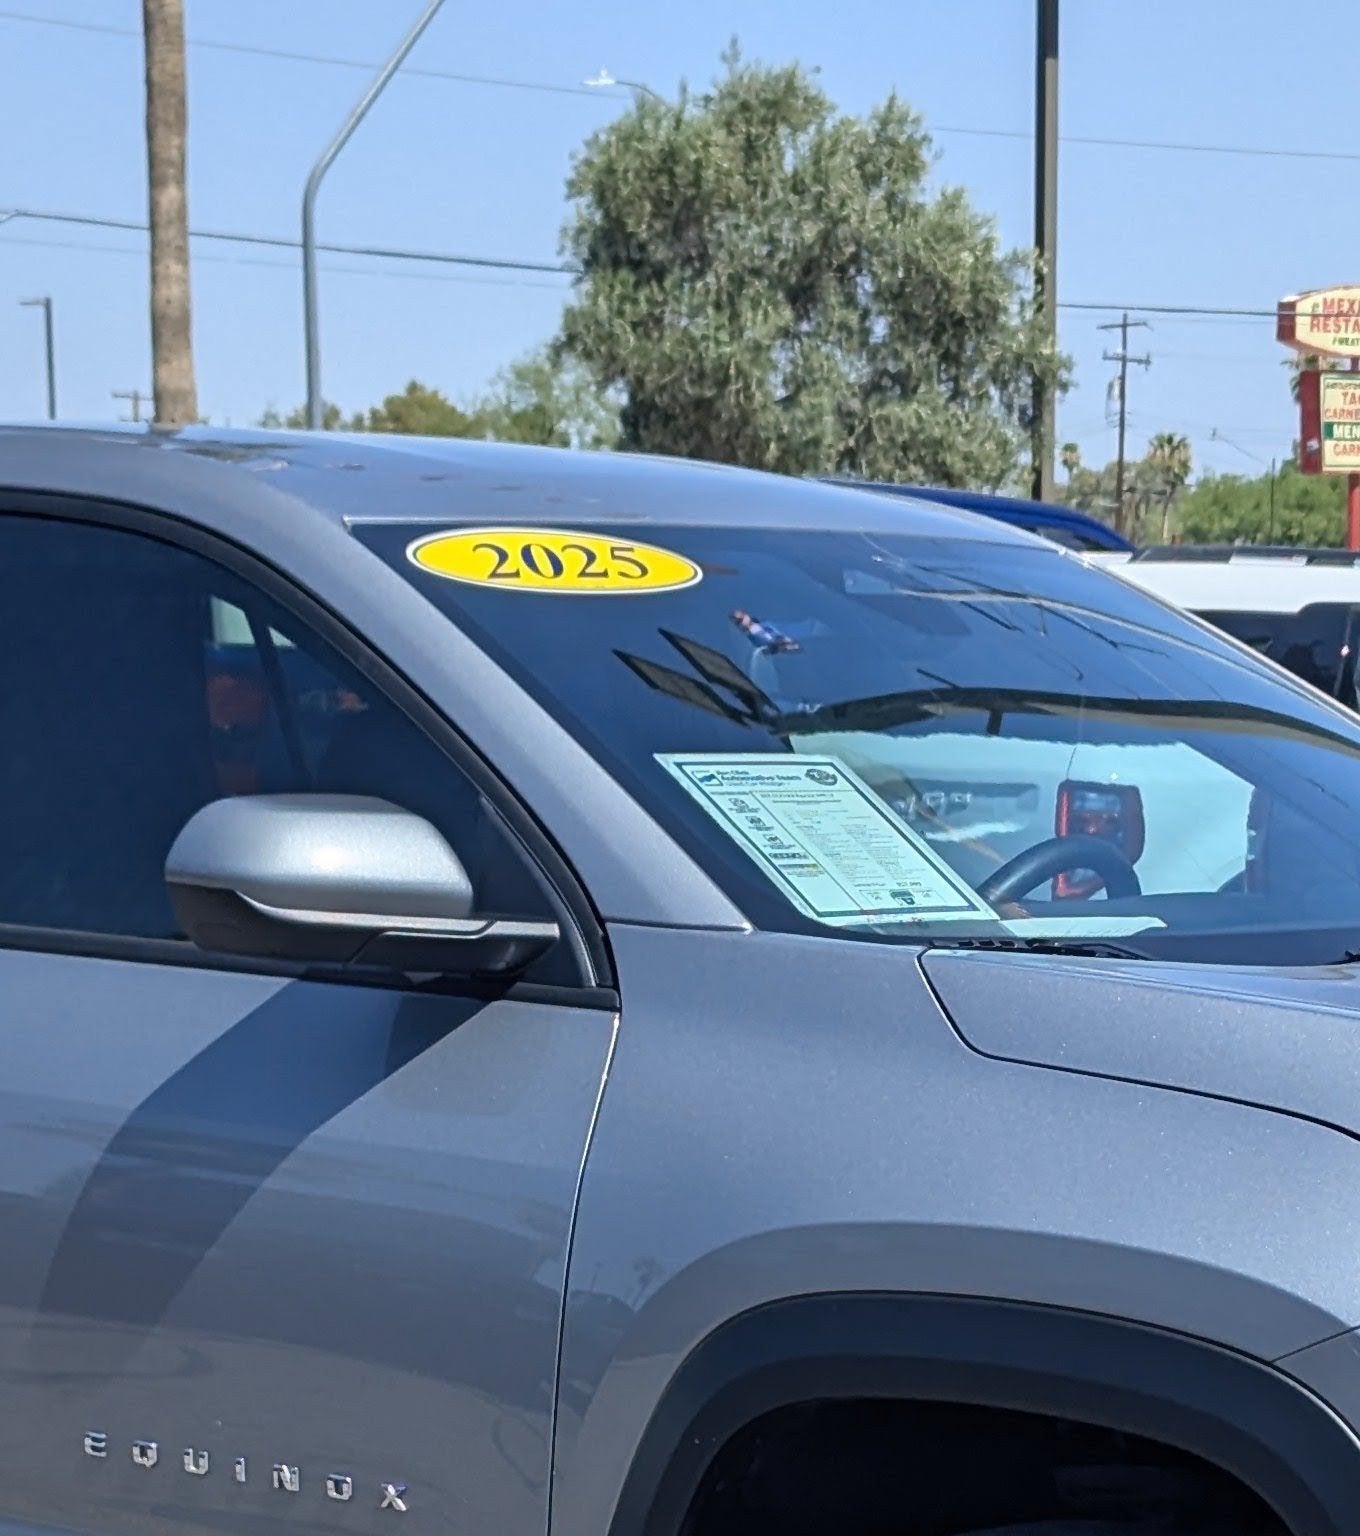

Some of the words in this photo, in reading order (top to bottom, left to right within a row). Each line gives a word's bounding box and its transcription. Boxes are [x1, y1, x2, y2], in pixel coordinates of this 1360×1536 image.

[1324, 408, 1360, 420] CARNE
[471, 542, 650, 580] 2025
[83, 1429, 408, 1513] EQUINOX
